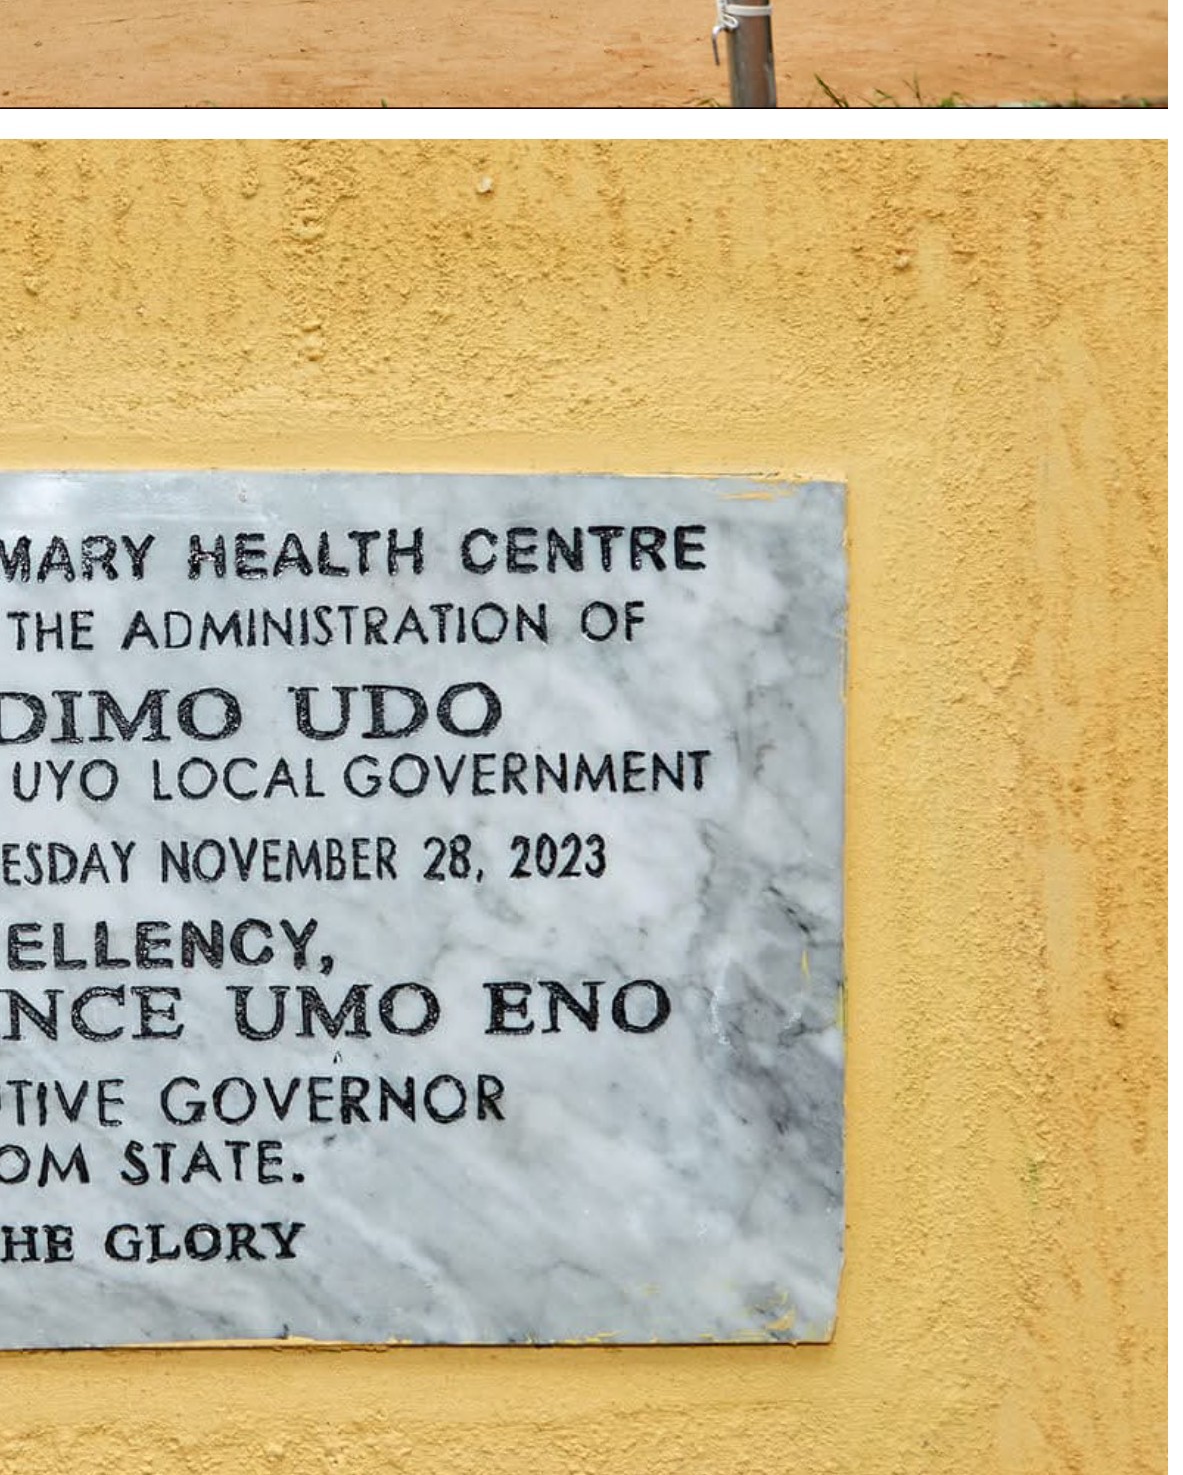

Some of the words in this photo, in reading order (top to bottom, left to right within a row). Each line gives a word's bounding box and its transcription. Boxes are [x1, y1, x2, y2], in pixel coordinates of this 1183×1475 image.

[188, 528, 424, 580] HEALTH
[461, 525, 706, 575] CENTRE
[7, 611, 94, 652] THE
[121, 602, 548, 650] ADMINISTRATION
[581, 601, 644, 642] OF
[288, 682, 502, 740] UDO
[13, 759, 118, 802] UYO
[153, 757, 325, 800] LOCAL
[344, 750, 711, 798] GOVERNMENT
[161, 837, 397, 883] NOVEMBER
[423, 834, 483, 882] 28,
[510, 833, 606, 879] 2023
[226, 982, 440, 1041] UMO
[483, 980, 671, 1035] ENO
[161, 1074, 505, 1126] GOVERNOR
[121, 1140, 304, 1185] STATE.
[105, 1222, 305, 1263] GLORY
